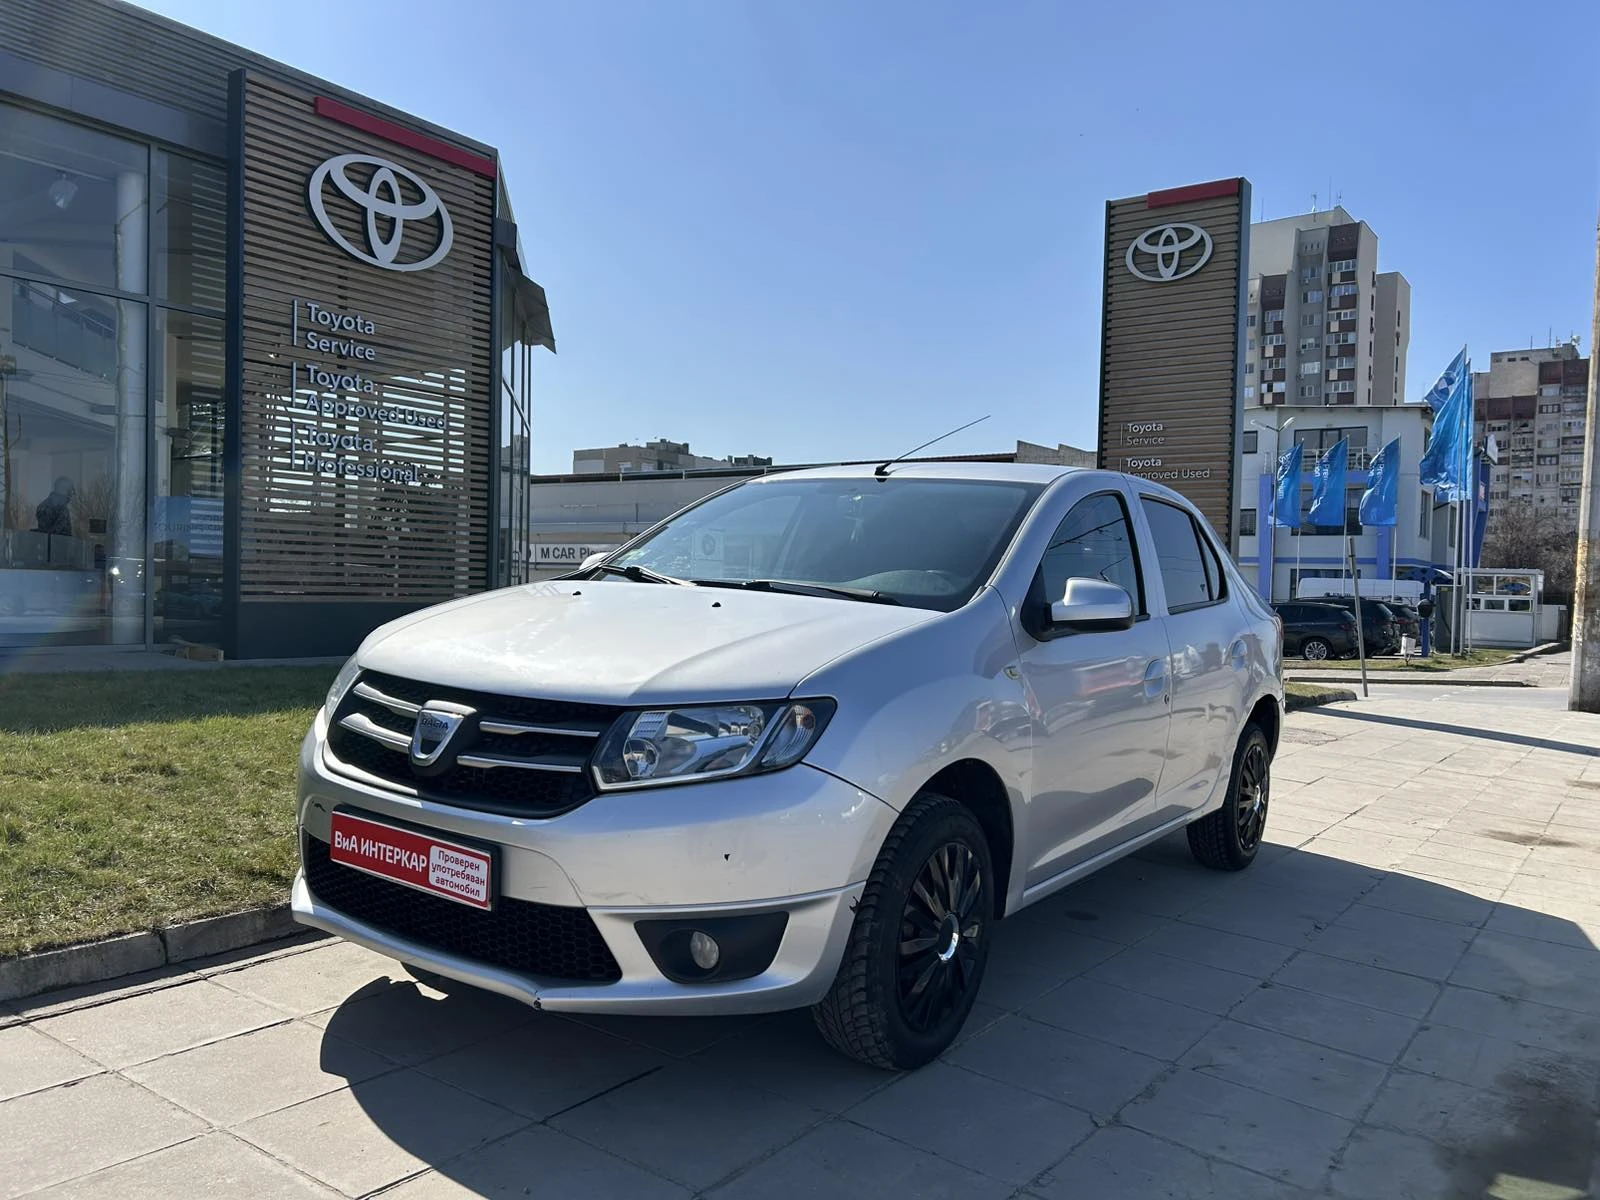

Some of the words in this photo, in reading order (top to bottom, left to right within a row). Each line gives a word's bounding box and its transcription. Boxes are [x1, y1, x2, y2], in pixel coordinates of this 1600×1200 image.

[306, 302, 375, 335] Toyota
[306, 331, 376, 360] Service
[305, 364, 374, 393] Toyota
[306, 393, 399, 423] Approved
[404, 408, 447, 430] Used
[304, 425, 374, 452] Toyota
[1126, 435, 1165, 446] Service
[1127, 423, 1163, 435] Toyota
[304, 453, 419, 482] Professional
[1126, 457, 1162, 469] Toyota
[1182, 468, 1210, 479] Used
[552, 546, 577, 560] CAR
[334, 830, 359, 853] ВиА
[360, 837, 428, 873] ИНТЕРКАР
[438, 850, 480, 871] Проверен
[431, 862, 485, 887] употребяван
[435, 875, 480, 898] автомобил
